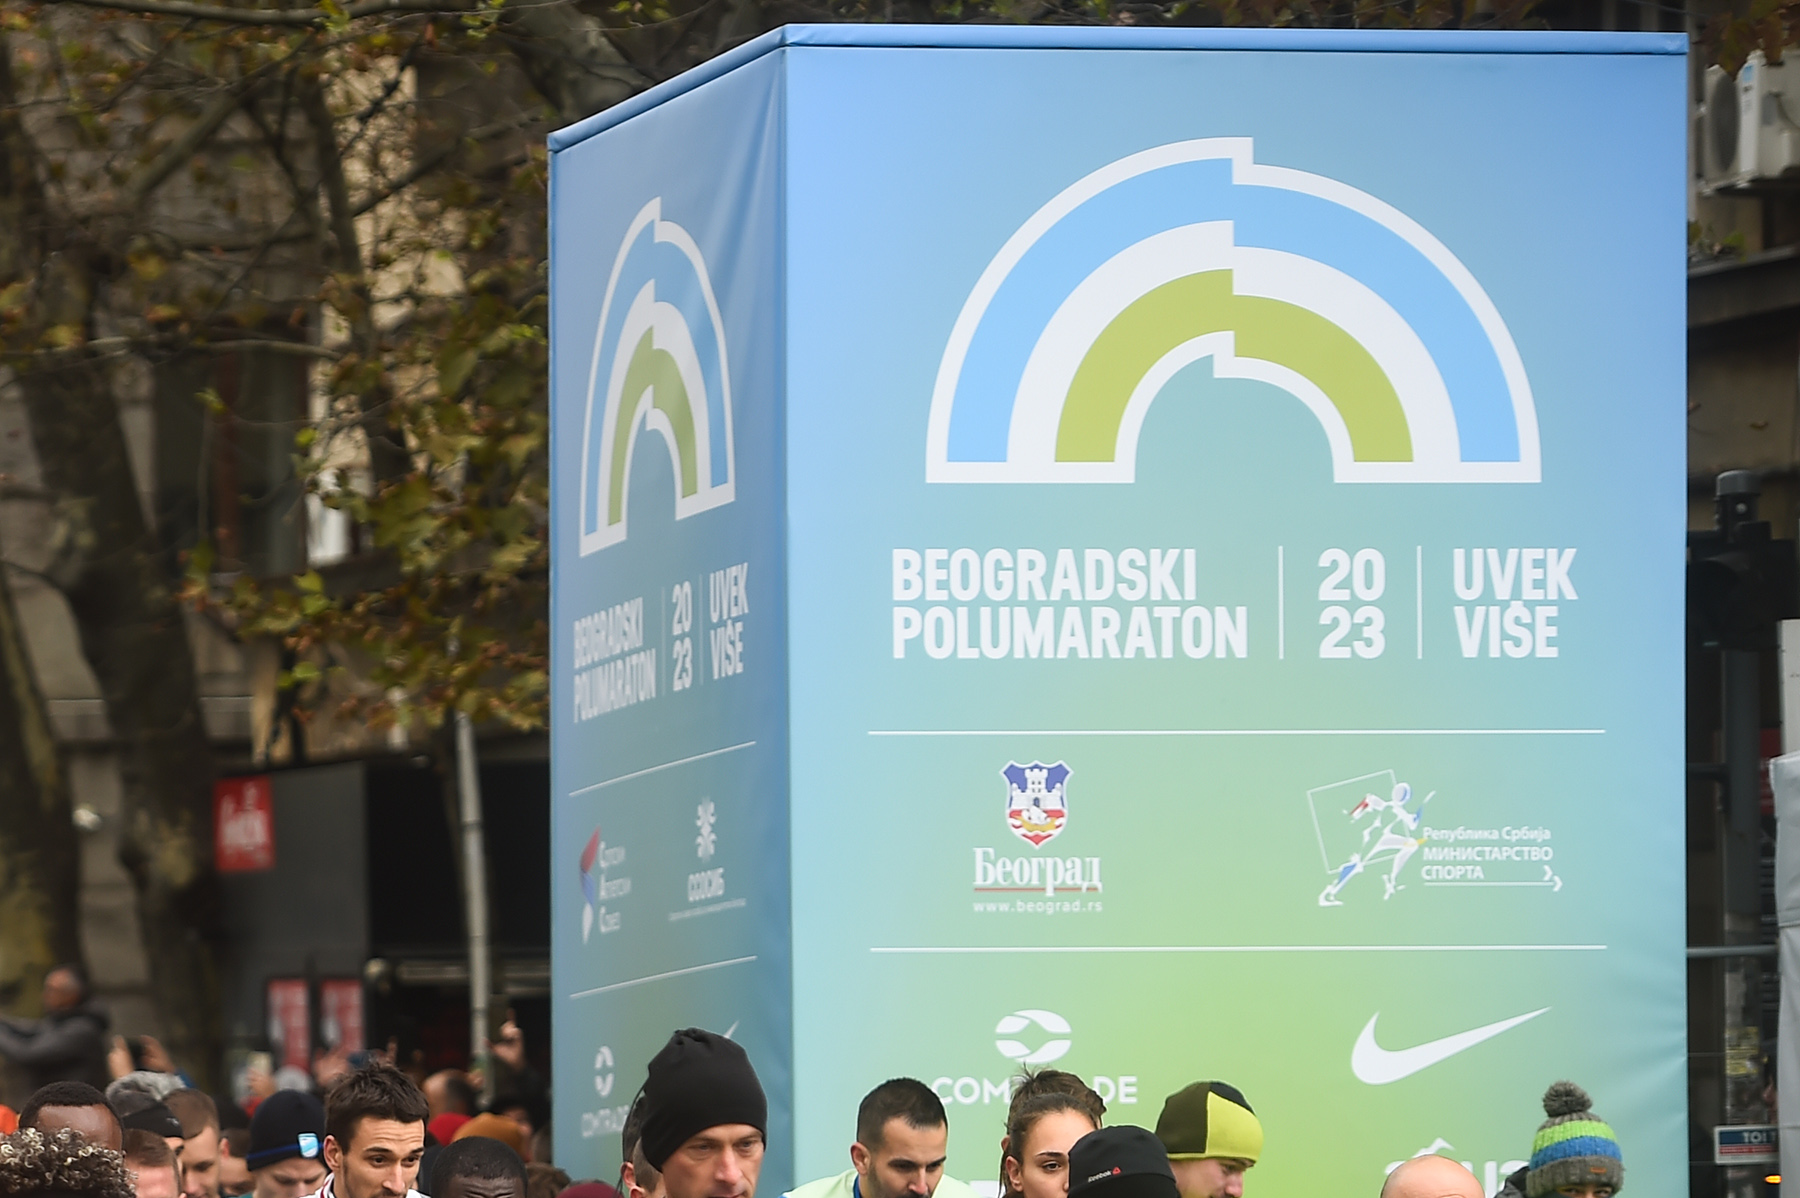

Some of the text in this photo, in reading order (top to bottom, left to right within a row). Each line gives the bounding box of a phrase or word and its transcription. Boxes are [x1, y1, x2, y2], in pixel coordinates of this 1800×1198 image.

[709, 562, 749, 624] UVEK
[892, 548, 1197, 600] BEOGRADSKI
[1318, 548, 1386, 600] 20
[1453, 548, 1579, 600] UVEK
[672, 580, 692, 636] 20
[892, 606, 1248, 659] POLUMARATON
[1318, 605, 1386, 658] 23
[1454, 600, 1559, 658] VIŠE
[672, 637, 692, 691] 23
[973, 847, 1103, 896] Београд
[1421, 866, 1484, 880] СПОРТА
[1422, 847, 1553, 861] МИНИСТАРСТВО
[973, 900, 1103, 914] www.beograd.rs
[931, 1076, 1138, 1104] COMDE
